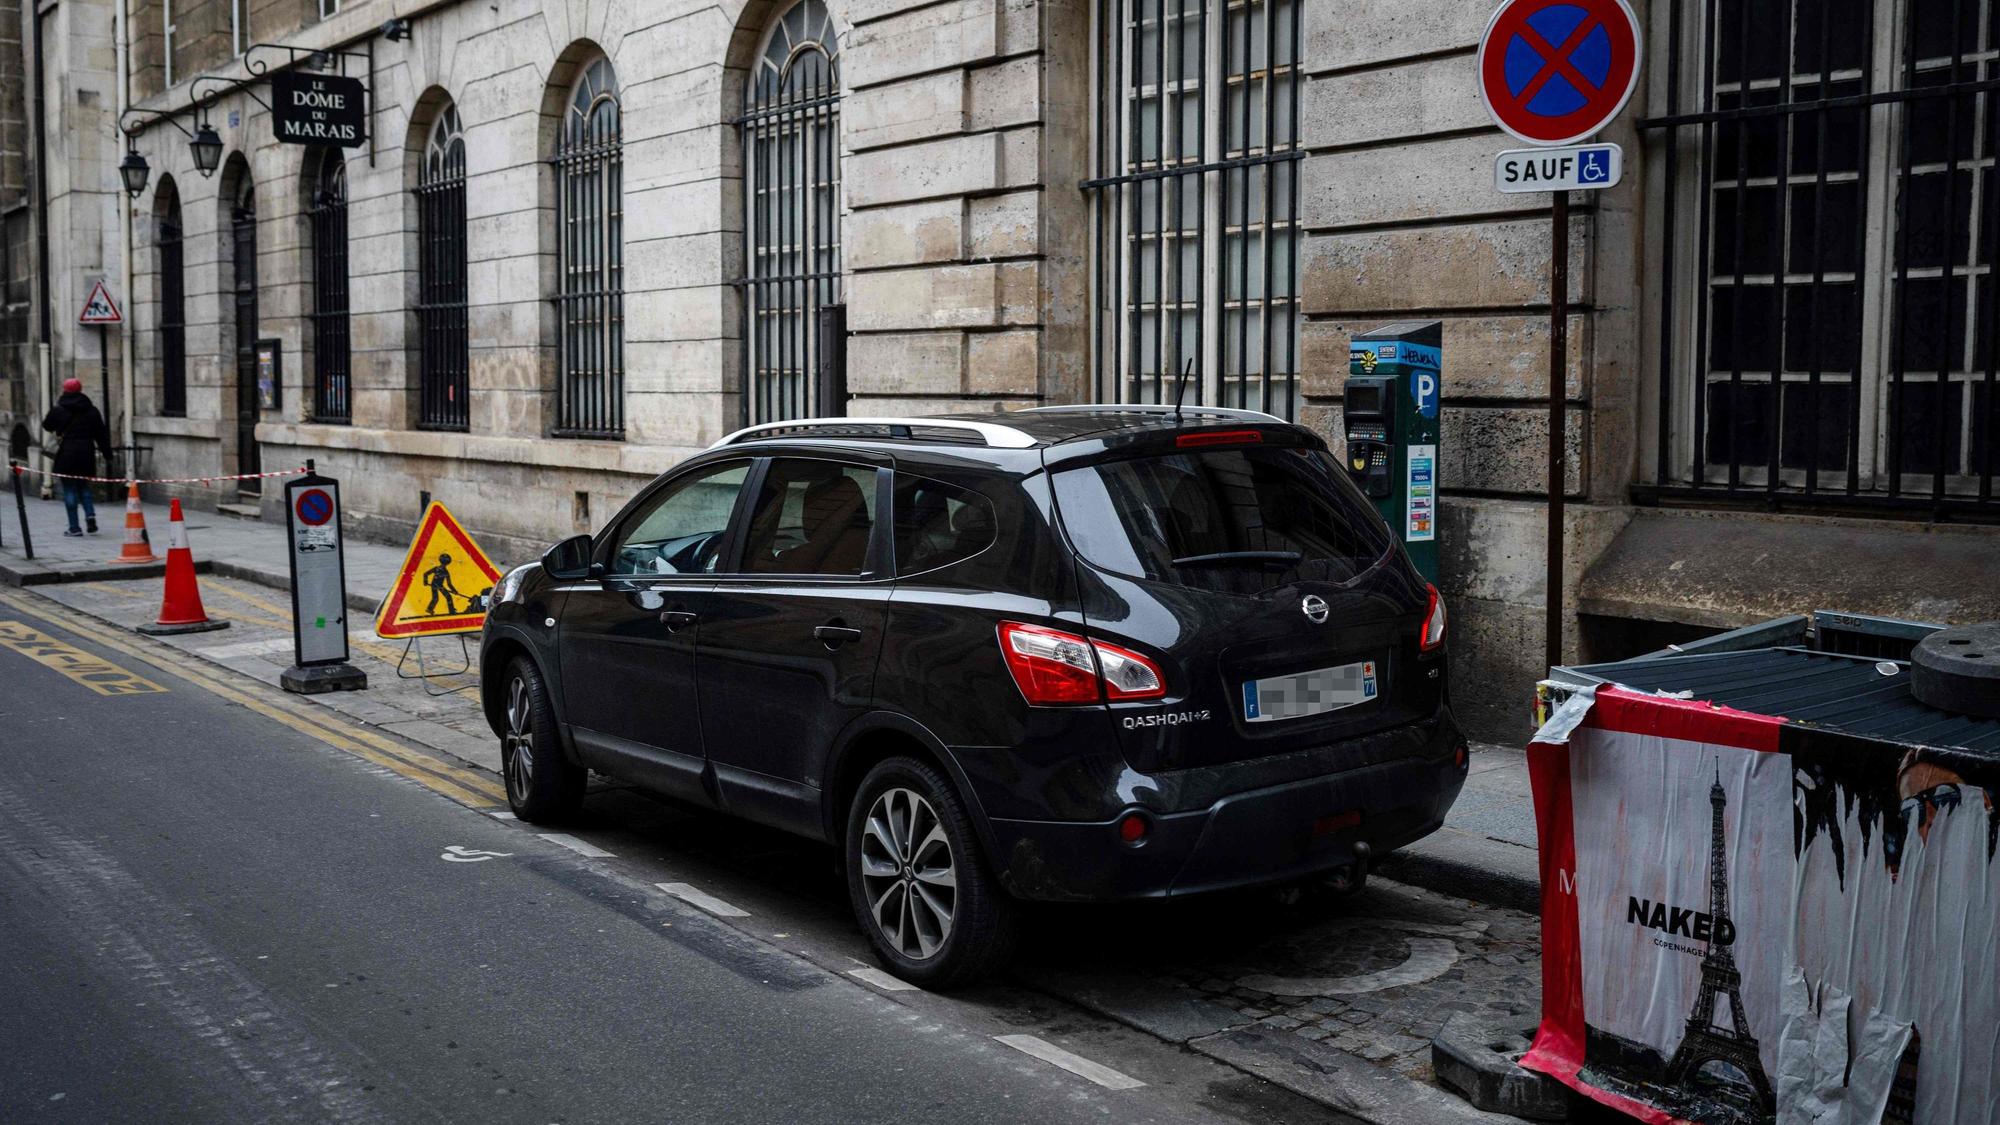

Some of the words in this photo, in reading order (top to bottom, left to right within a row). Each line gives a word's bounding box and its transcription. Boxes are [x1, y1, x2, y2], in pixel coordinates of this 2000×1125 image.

[312, 81, 325, 90] LE
[293, 91, 345, 109] DÔME
[312, 111, 327, 120] DU
[285, 120, 355, 140] MARAIS
[1505, 158, 1573, 182] SAUF
[1418, 374, 1434, 409] P
[1364, 679, 1375, 694] 77
[1627, 896, 1736, 946] NAKED
[1653, 938, 1709, 958] COPENHAGEN
